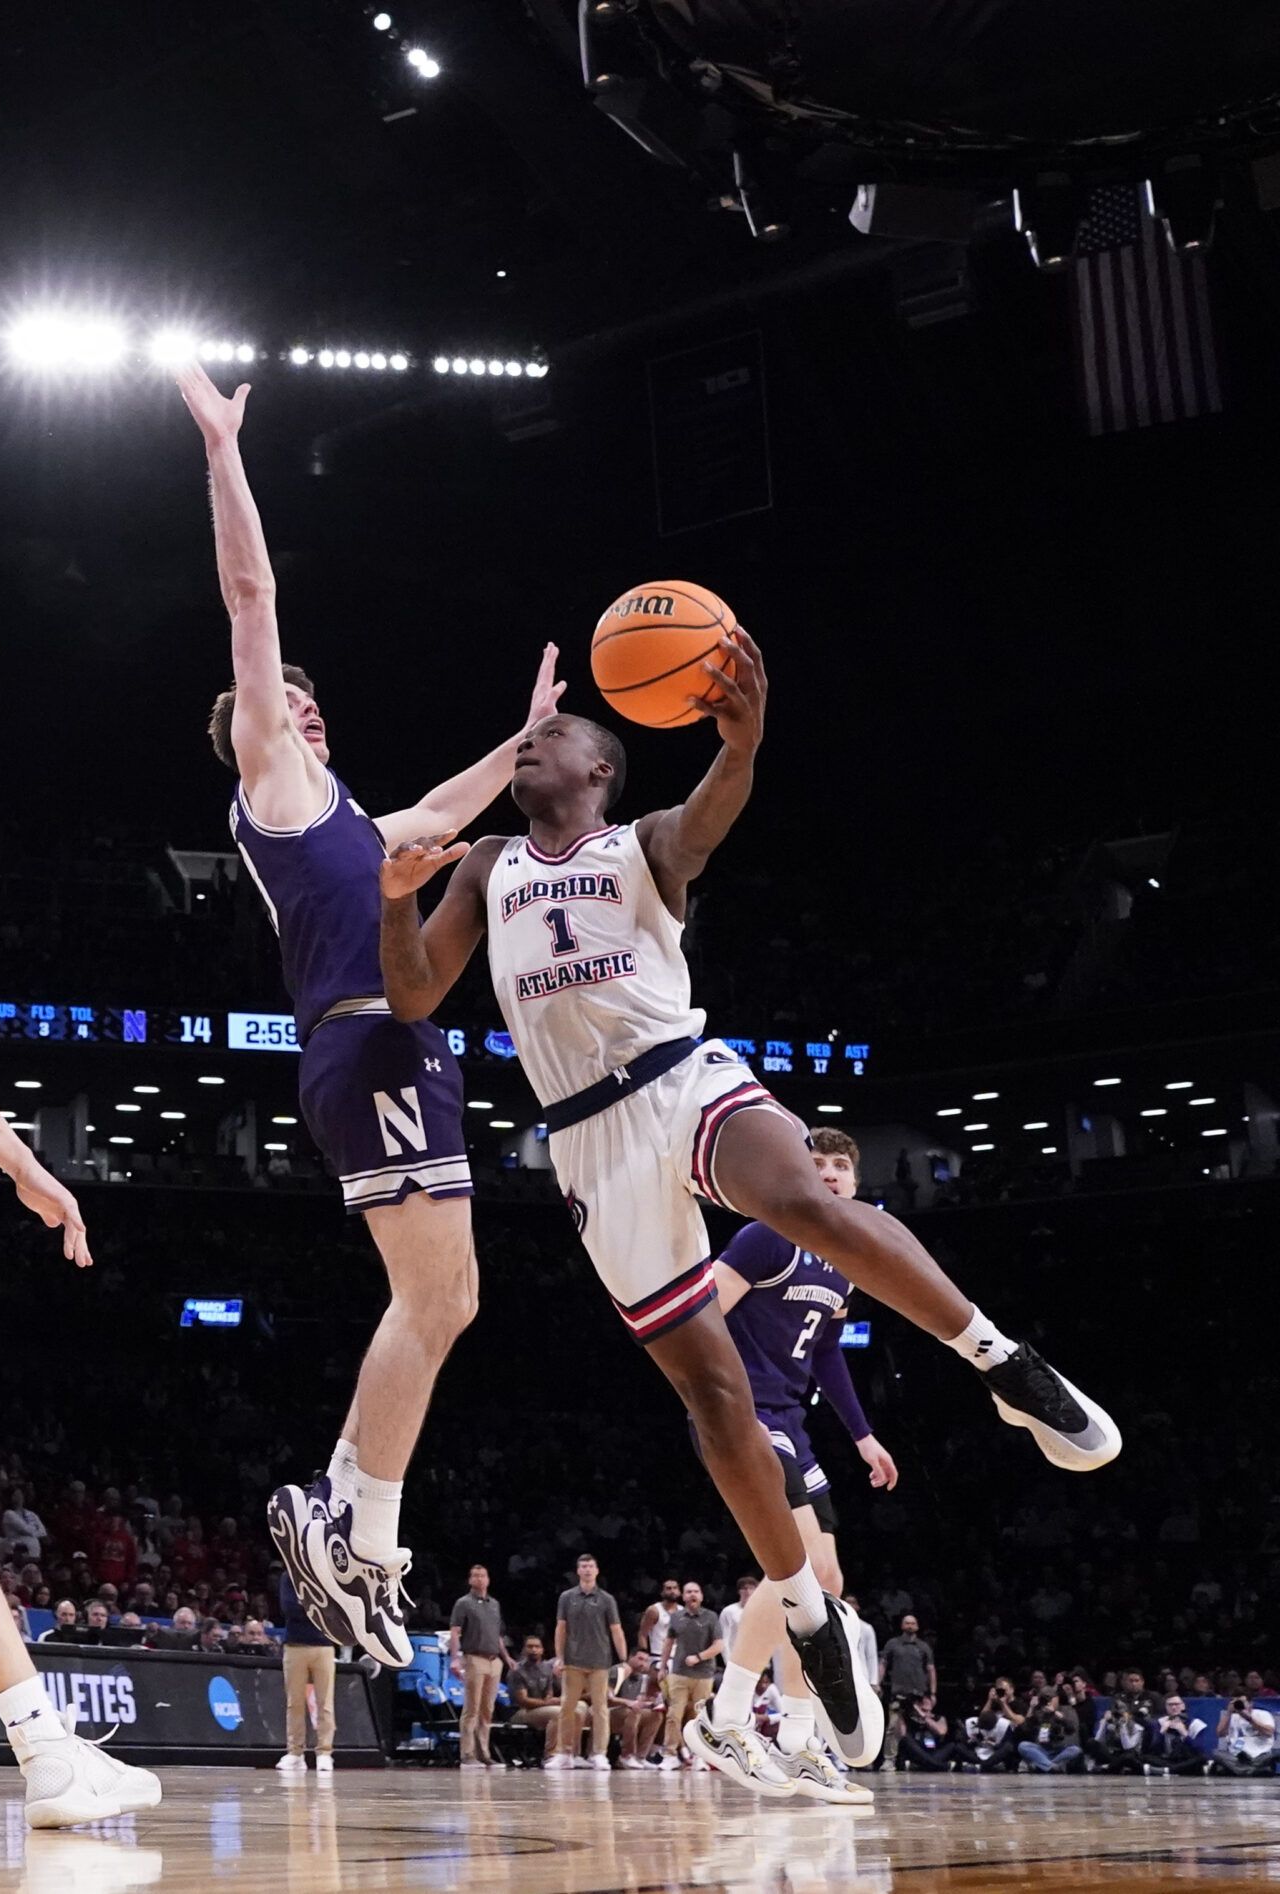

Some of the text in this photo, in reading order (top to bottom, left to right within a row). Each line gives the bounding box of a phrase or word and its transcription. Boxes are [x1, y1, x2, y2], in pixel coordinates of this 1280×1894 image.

[503, 875, 622, 921] FLORIDA
[545, 907, 578, 956] 1
[518, 952, 636, 1000] ATLANTIC
[31, 1005, 56, 1020] FLS
[38, 1022, 50, 1036] 3
[77, 1024, 89, 1039] 4
[180, 1015, 212, 1043] 14
[245, 1020, 297, 1046] 2:59
[766, 1040, 793, 1056] FT%
[806, 1043, 832, 1058] REB
[845, 1045, 869, 1059] AST
[814, 1059, 828, 1074] 17
[854, 1061, 863, 1075] 2
[373, 1085, 428, 1157] N
[791, 1309, 822, 1359] 2
